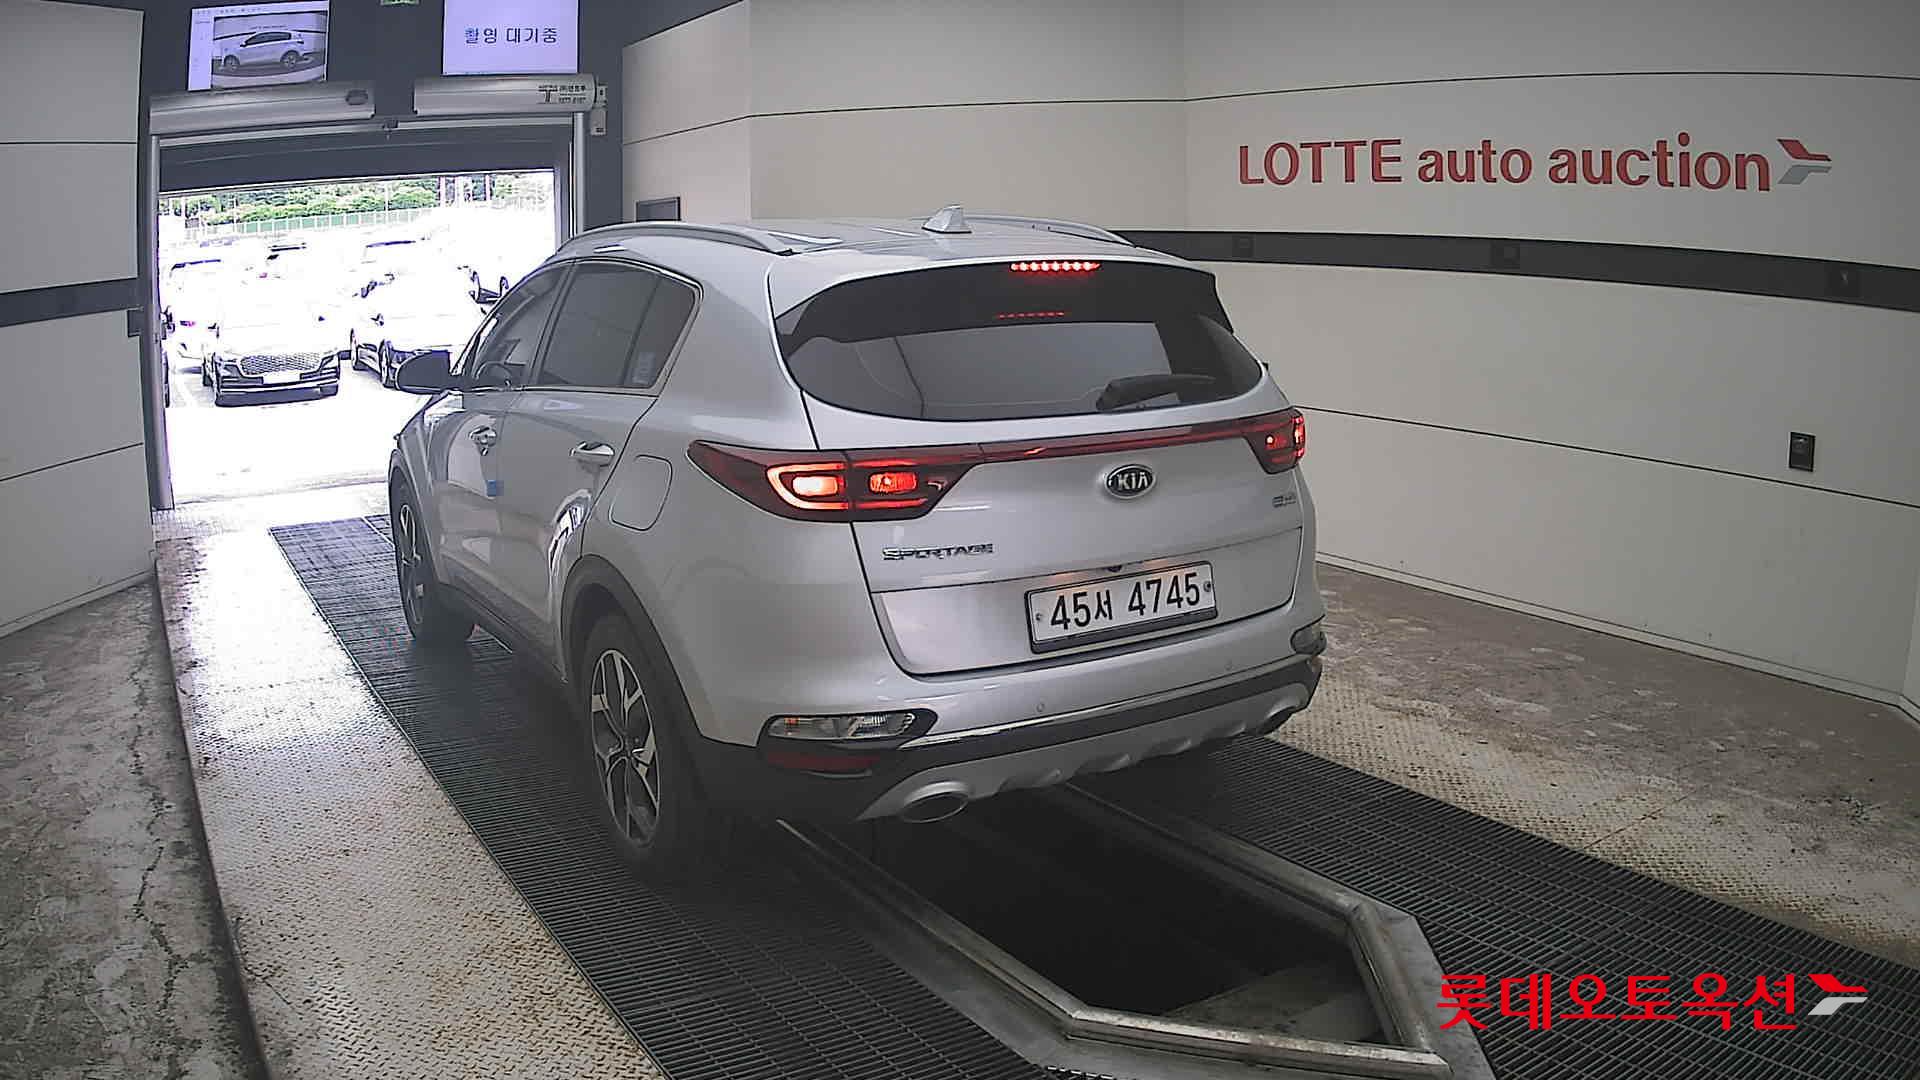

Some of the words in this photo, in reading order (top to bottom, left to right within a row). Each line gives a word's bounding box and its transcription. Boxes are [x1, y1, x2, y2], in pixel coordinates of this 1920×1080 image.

[506, 27, 558, 43] 대기중
[1238, 138, 1403, 185] LOTTE
[1417, 139, 1532, 184] auto
[1548, 131, 1771, 192] auction
[1114, 470, 1149, 491] KIA
[882, 543, 993, 560] SPORTAGE
[1050, 588, 1113, 630] 45서
[1127, 572, 1201, 616] 4745
